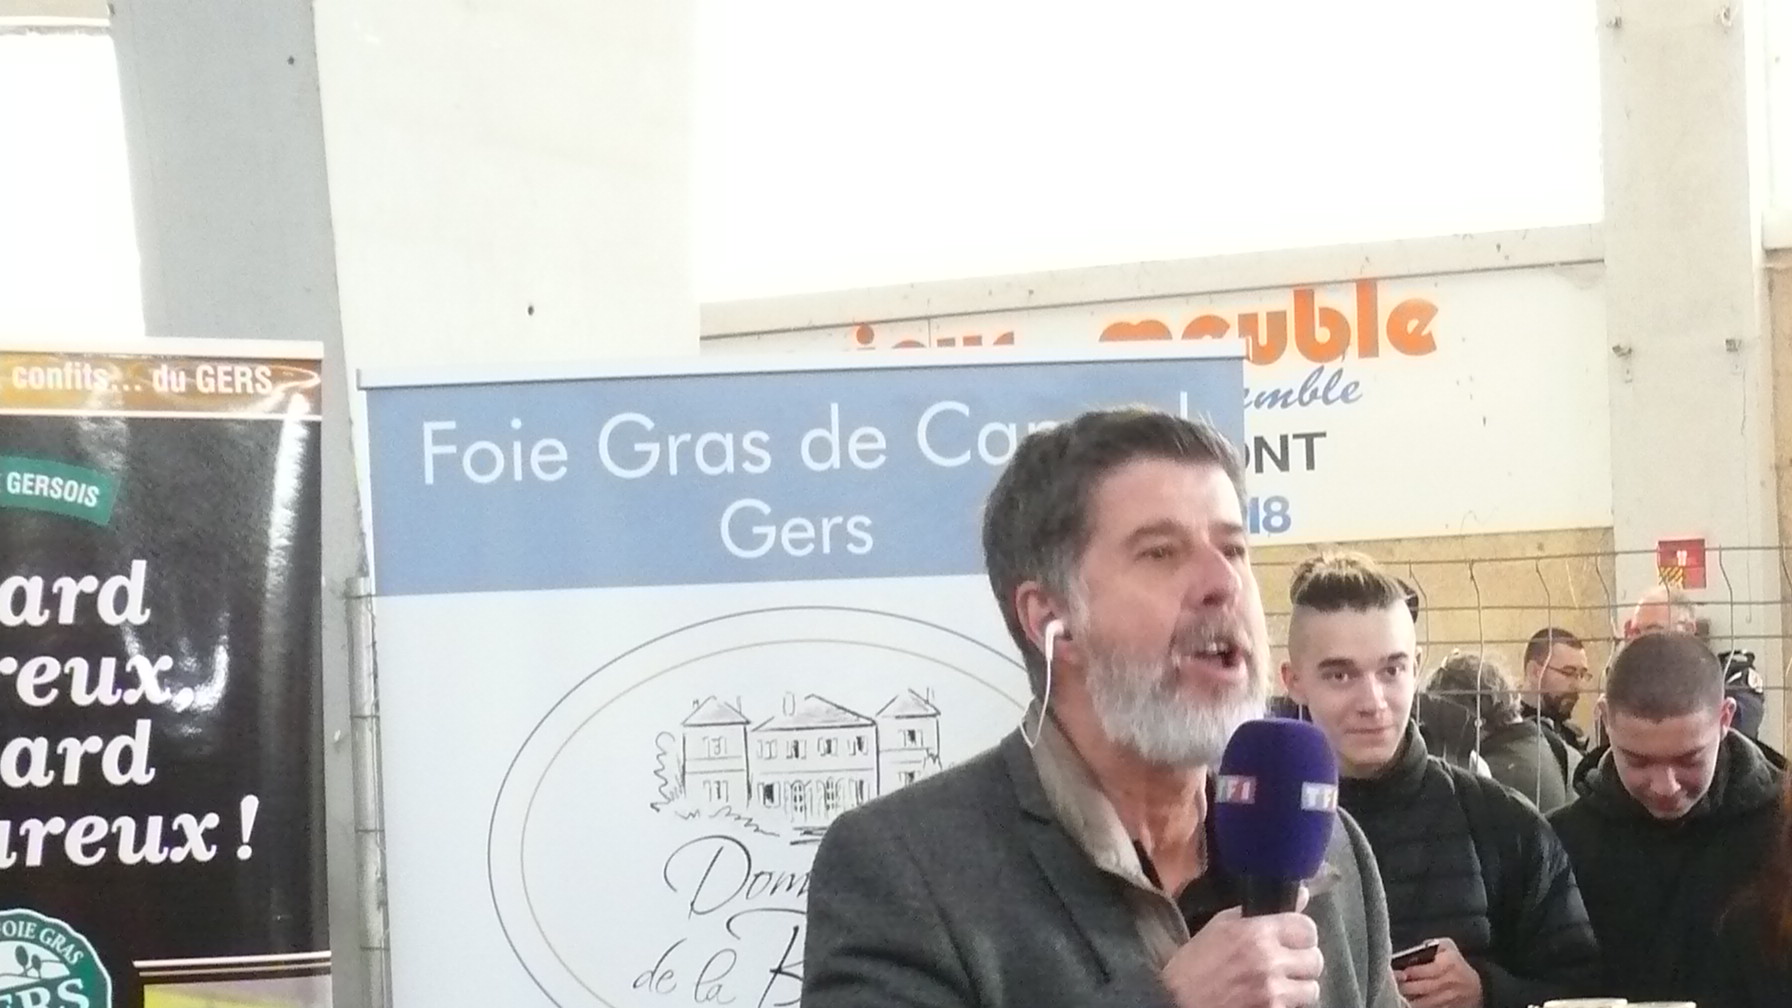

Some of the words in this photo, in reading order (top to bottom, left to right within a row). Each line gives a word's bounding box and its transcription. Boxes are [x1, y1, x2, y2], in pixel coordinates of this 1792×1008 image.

[153, 363, 189, 393] du
[196, 364, 273, 395] GERS
[422, 418, 569, 486] Foie
[597, 411, 772, 480] Gras
[800, 402, 887, 473] de
[1244, 431, 1327, 475] NT
[7, 471, 100, 508] GERSOIS
[720, 498, 874, 560] Gers
[39, 927, 84, 965] GRAS
[633, 938, 677, 993] de
[694, 948, 736, 1005] la
